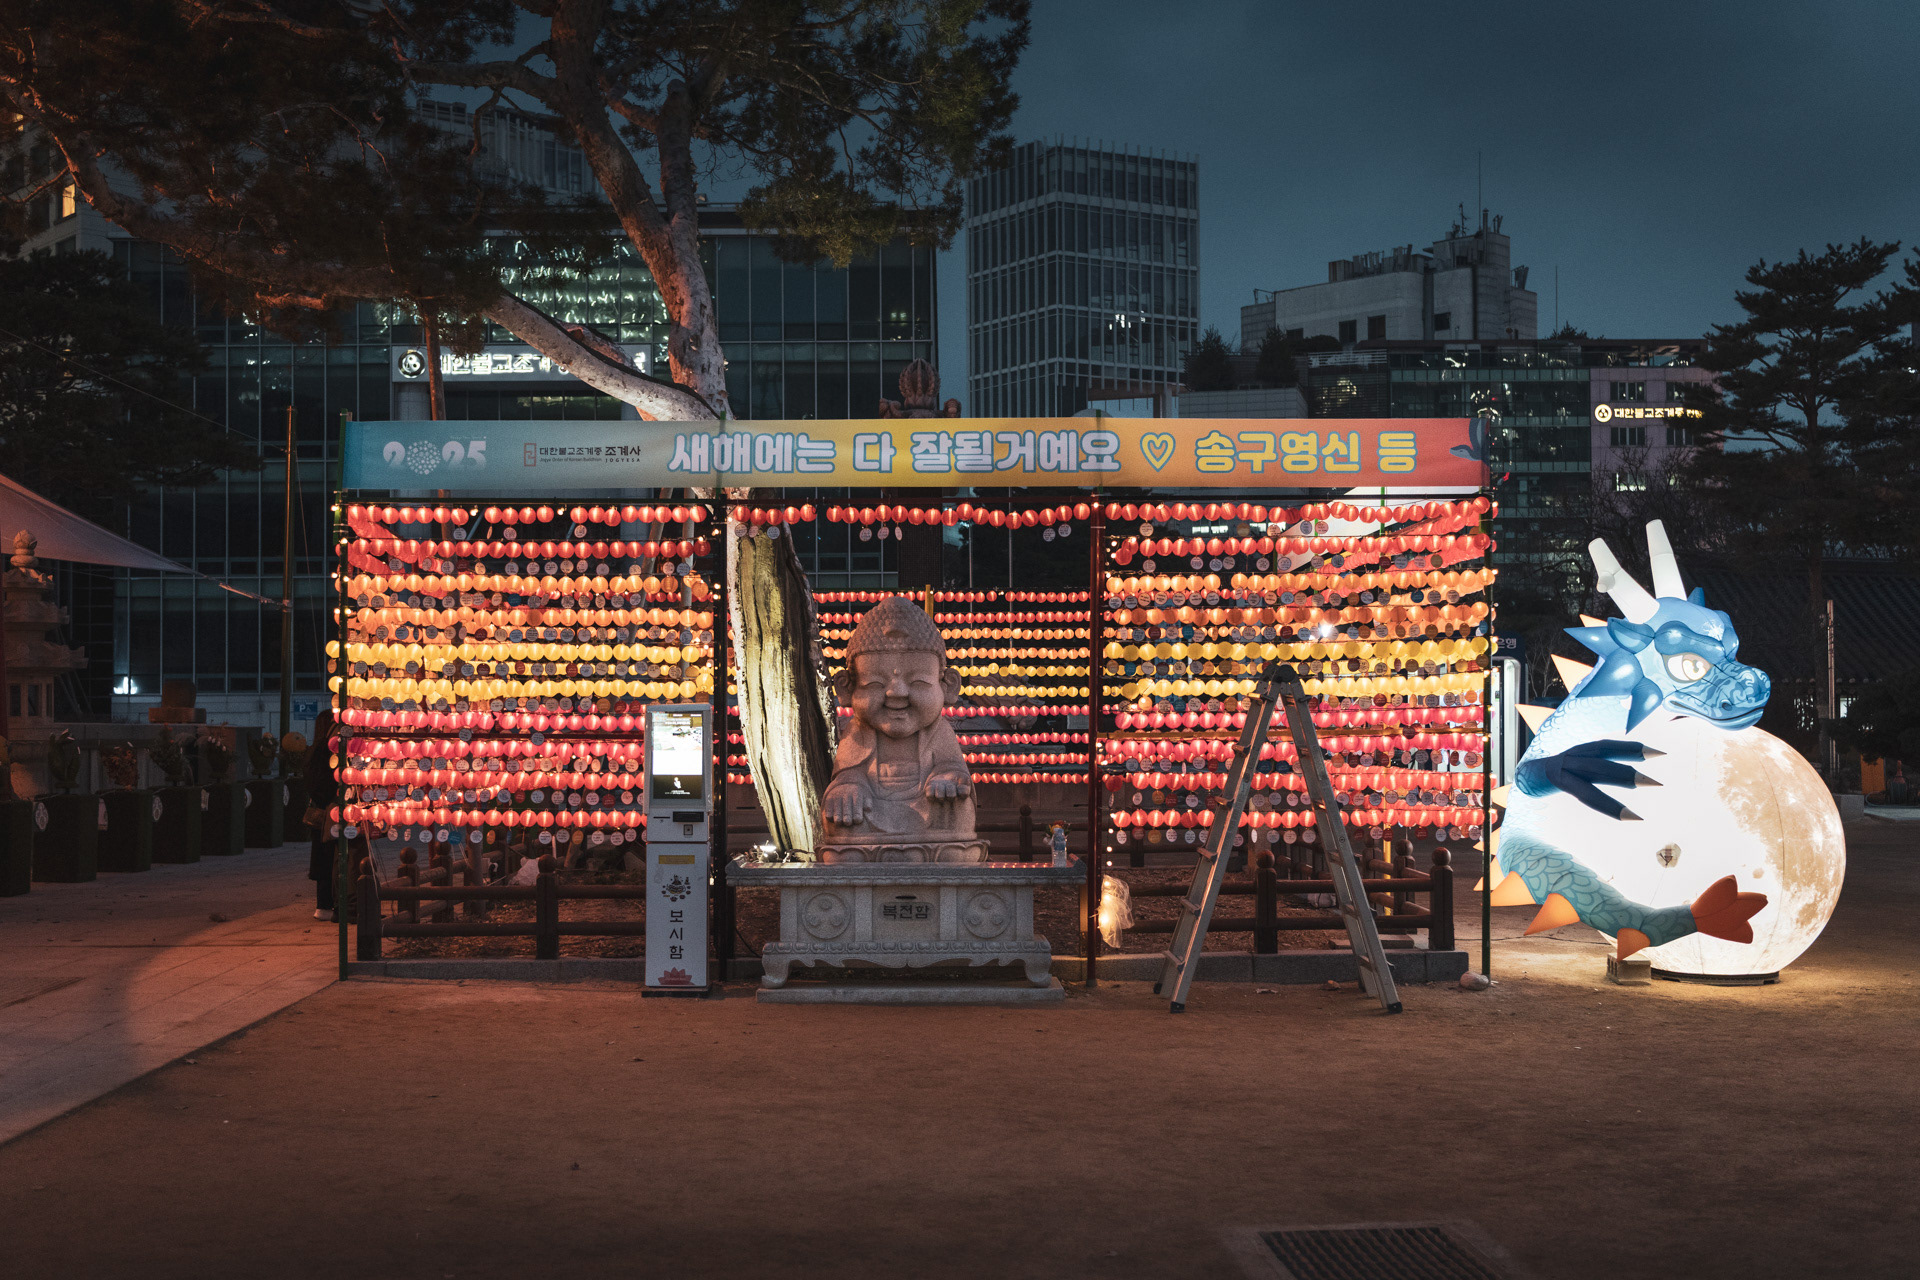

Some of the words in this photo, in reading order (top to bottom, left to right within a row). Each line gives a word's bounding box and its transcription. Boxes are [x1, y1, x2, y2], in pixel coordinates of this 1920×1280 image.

[540, 447, 602, 456] 대한불교조계종
[605, 446, 641, 456] 조계사
[668, 431, 836, 474] 새해에는
[852, 432, 897, 474] 다
[910, 430, 1122, 474] 잘될거예요
[1195, 430, 1361, 474] 송구영신
[1376, 431, 1418, 474] 등
[882, 904, 930, 920] 복전함
[669, 910, 684, 960] 보시함
